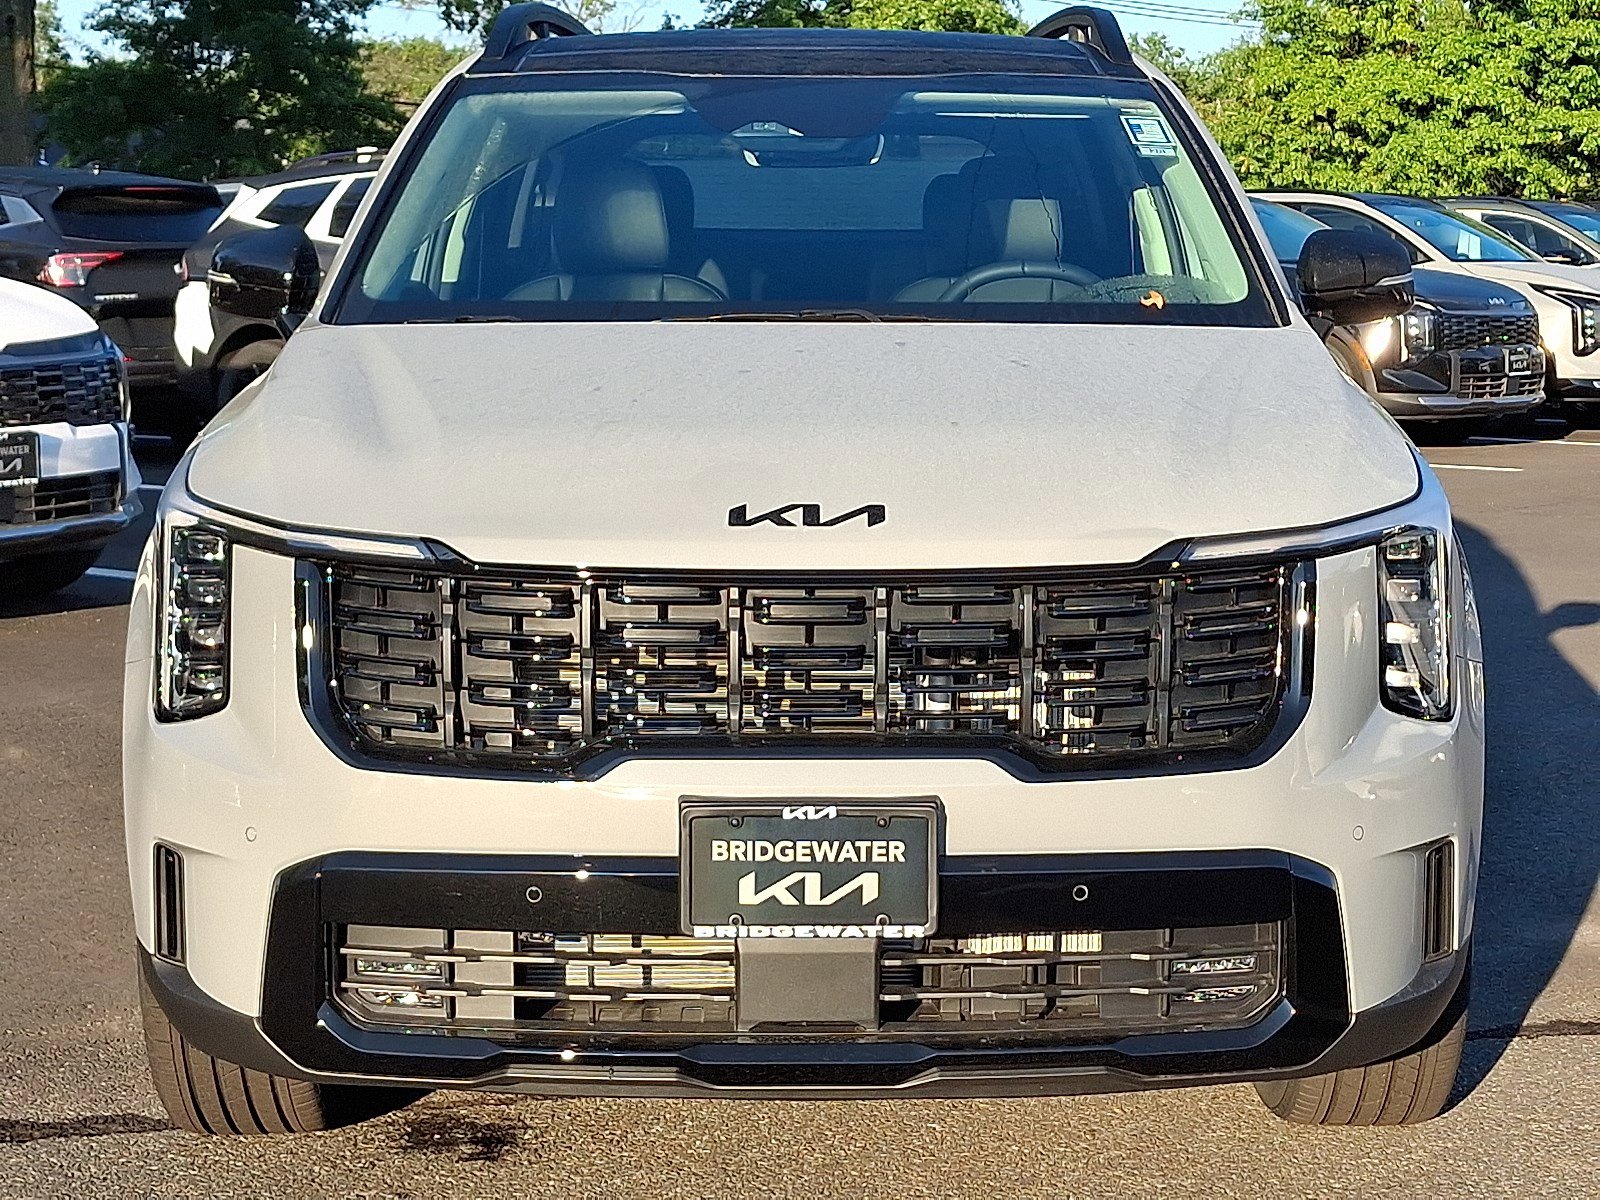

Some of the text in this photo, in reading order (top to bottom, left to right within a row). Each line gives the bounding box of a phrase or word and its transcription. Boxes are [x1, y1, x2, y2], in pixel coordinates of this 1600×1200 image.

[728, 503, 886, 528] KIA
[783, 805, 837, 820] KIA
[711, 839, 906, 863] BRIDGEWATER
[738, 871, 880, 906] KIA
[693, 924, 925, 938] BRIDGEWATER
